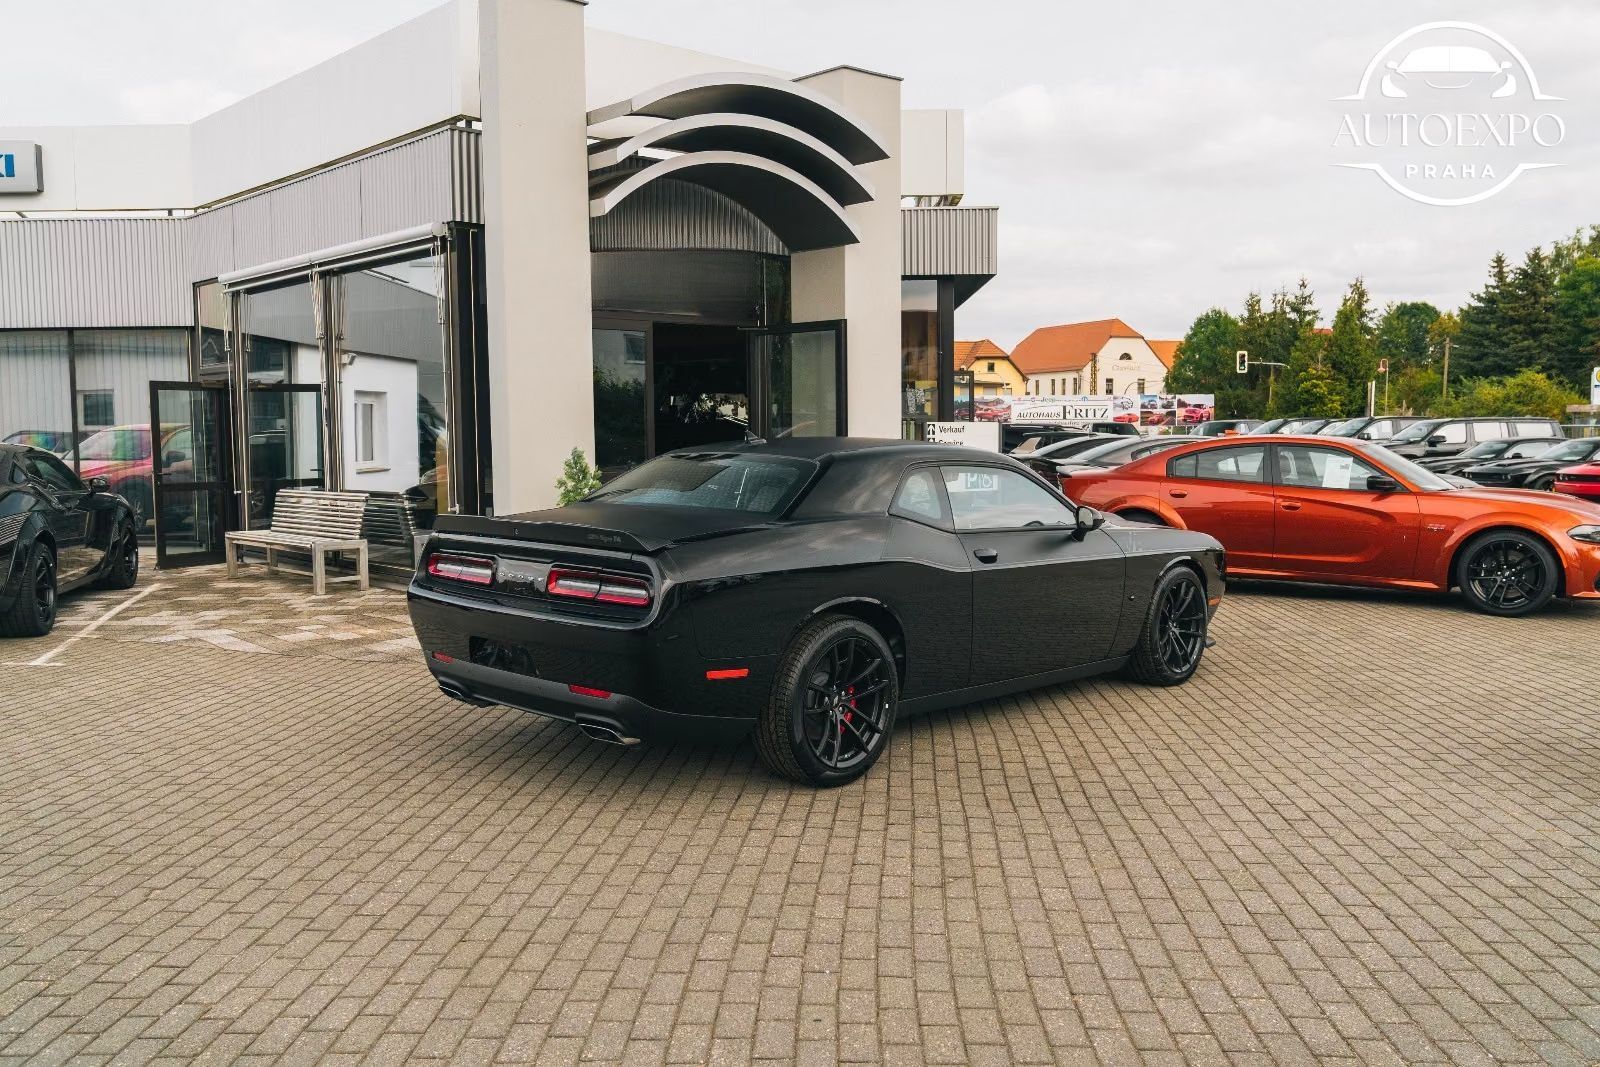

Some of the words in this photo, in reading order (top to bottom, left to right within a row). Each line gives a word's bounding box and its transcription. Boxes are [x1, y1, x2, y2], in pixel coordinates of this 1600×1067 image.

[0, 154, 15, 178] I
[1062, 405, 1109, 420] FRITZ
[939, 425, 965, 434] Verkauf
